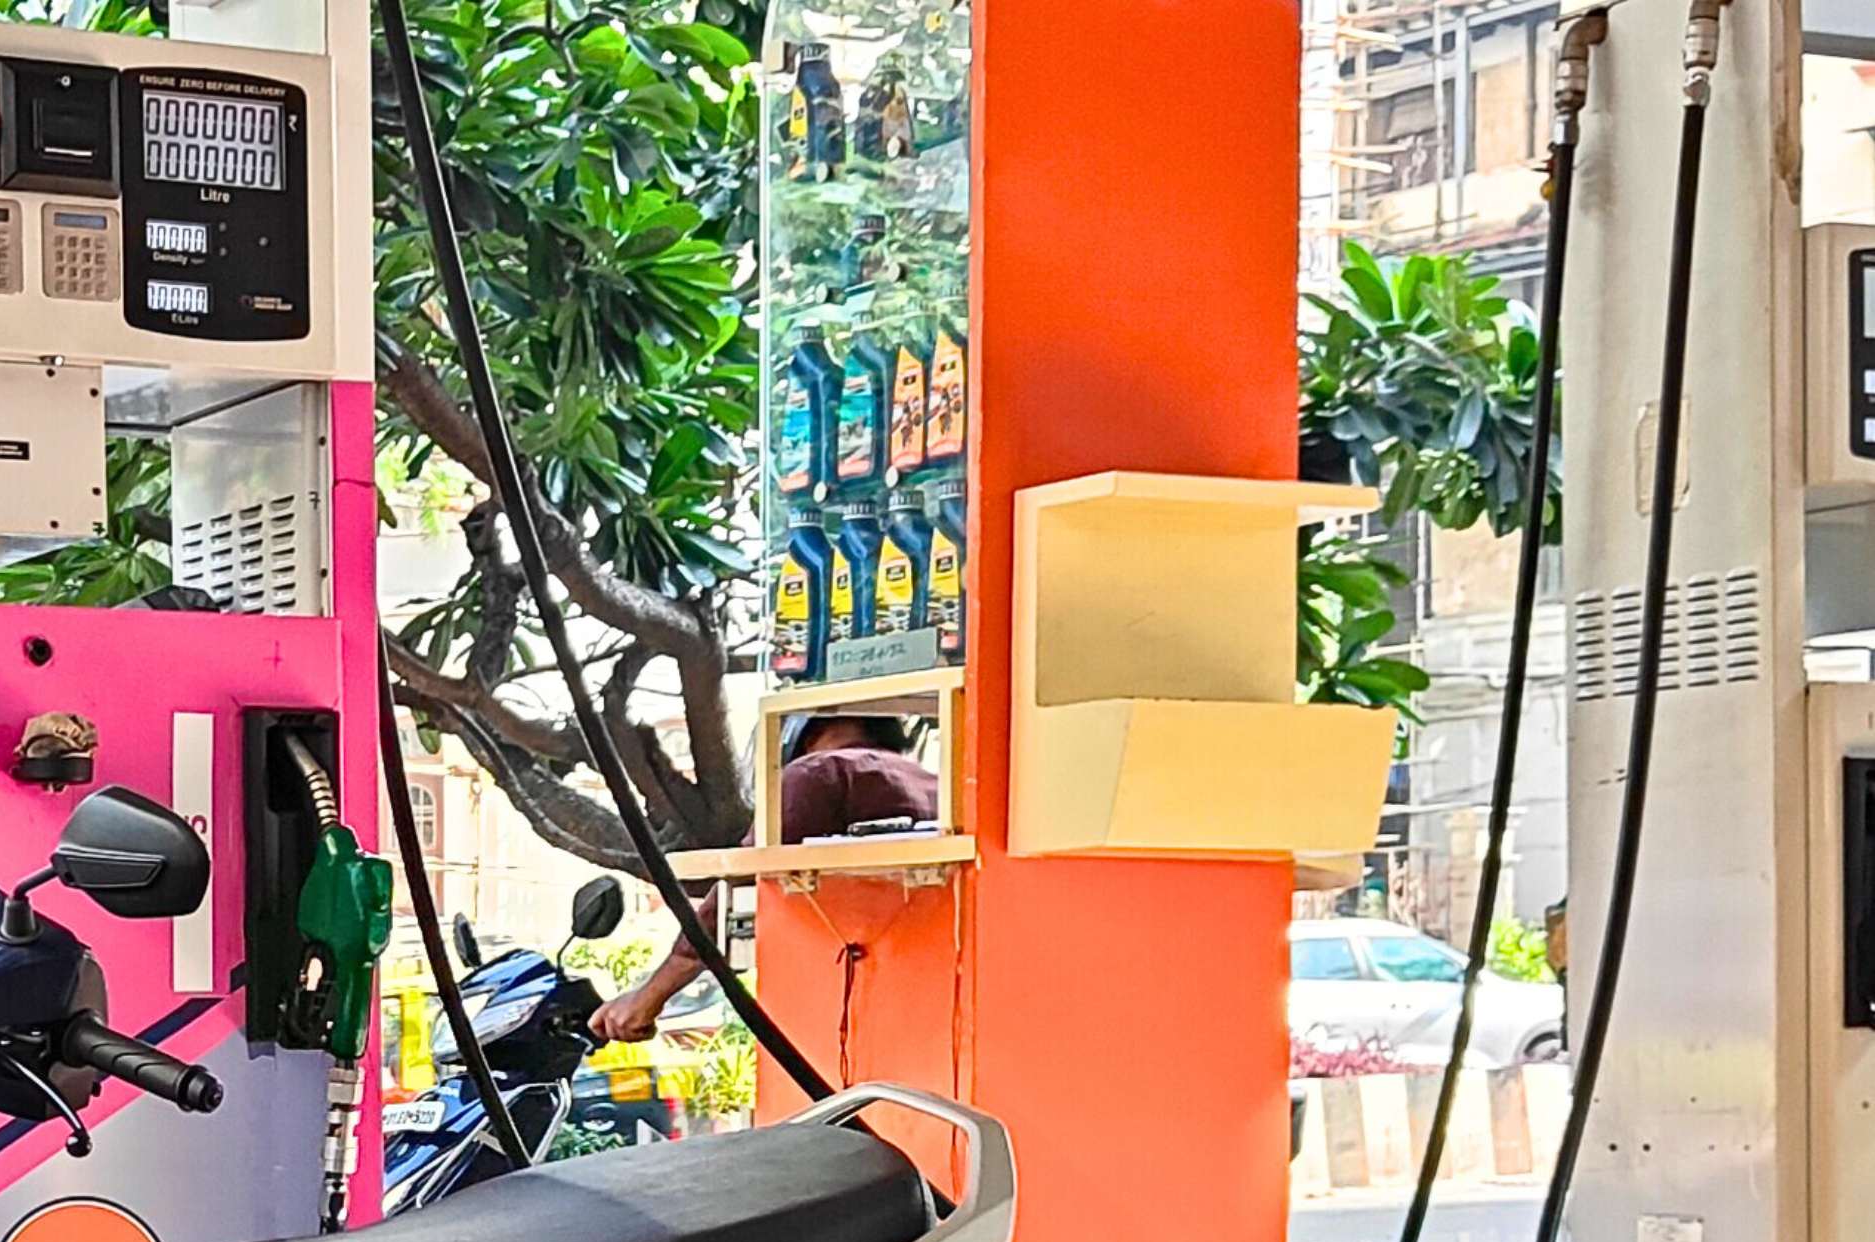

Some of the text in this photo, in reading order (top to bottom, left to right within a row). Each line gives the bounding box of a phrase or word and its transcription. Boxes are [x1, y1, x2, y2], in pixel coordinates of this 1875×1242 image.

[180, 78, 205, 89] ZERO
[206, 81, 242, 93] BEFORE
[243, 84, 285, 97] DELIVERY
[145, 97, 275, 145] 0000000
[146, 140, 276, 187] 0000000
[200, 187, 230, 203] Litre
